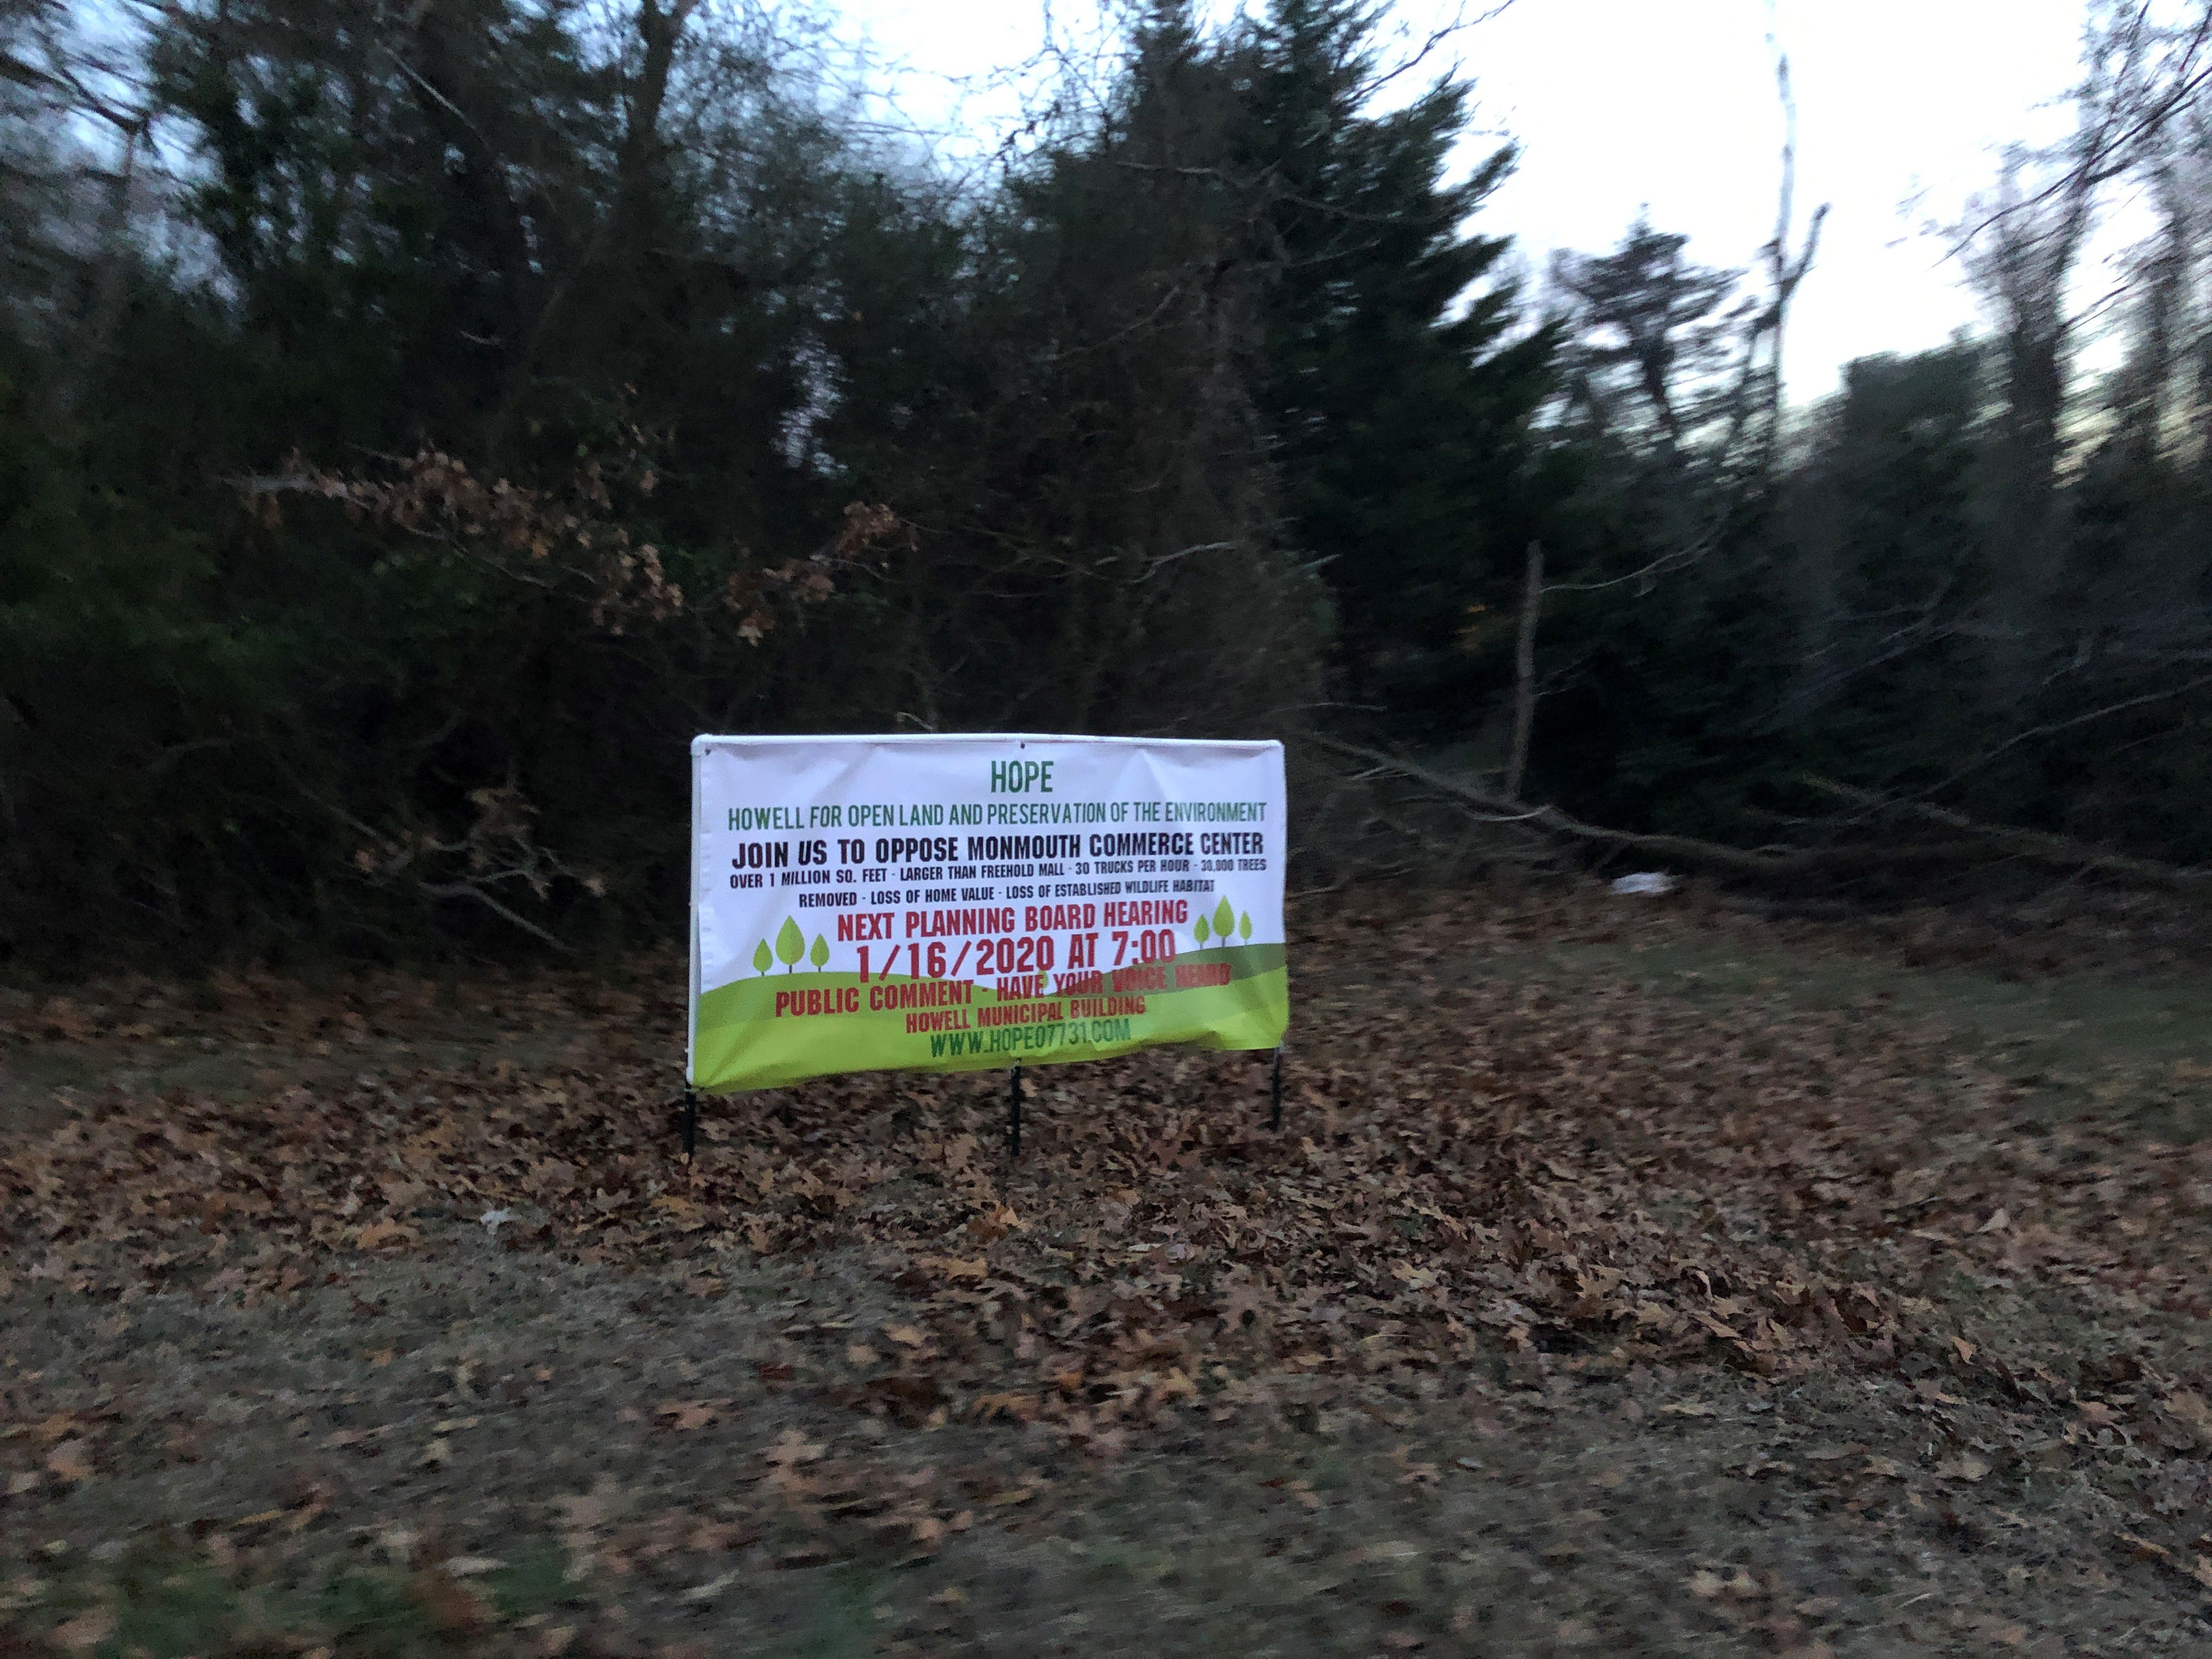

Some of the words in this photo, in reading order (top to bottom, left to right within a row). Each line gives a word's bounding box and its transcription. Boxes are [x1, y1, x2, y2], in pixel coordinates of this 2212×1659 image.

[991, 760, 1054, 793] HOPE
[729, 806, 804, 831] HOWELL
[810, 805, 842, 828] FOR
[848, 804, 894, 827] OPEN
[899, 804, 943, 826] LAND
[950, 804, 983, 825] AND
[987, 802, 1106, 825] PRESERVATION
[1110, 802, 1129, 822] OF
[1133, 802, 1160, 822] THE
[1165, 802, 1267, 822] ENVIRONMENT
[732, 841, 788, 870] JOIN
[798, 840, 827, 866] US
[837, 839, 865, 865] TO
[876, 837, 958, 862] OPPOSE
[968, 834, 1080, 861] MONMOUTH
[1090, 833, 1193, 857] COMMERCE
[1200, 832, 1263, 855] CENTER
[730, 873, 763, 889] OVER
[770, 873, 775, 887] 1
[781, 870, 830, 886] MILLION
[862, 868, 887, 882] FEET
[900, 866, 943, 881] LARGER
[948, 865, 976, 879] THAN
[981, 864, 1034, 878] FREEHOLD
[1039, 862, 1064, 877] MALL
[1075, 862, 1090, 874] 30
[1094, 861, 1133, 874] TRUCKS
[1138, 860, 1156, 872] PER
[1160, 859, 1189, 872] HOUR
[1238, 858, 1267, 871] TREES
[799, 892, 856, 908] REMOVED
[871, 890, 900, 905] LOSS
[906, 889, 920, 903] OF
[925, 888, 956, 903] HOME
[962, 887, 994, 901] VALUE
[1006, 885, 1034, 899] LOSS
[1039, 884, 1051, 898] OF
[1055, 881, 1121, 896] ESTABLISHED
[1125, 880, 1168, 893] WILDLIFE
[1173, 879, 1215, 892] HABITAT
[838, 912, 895, 941] NEXT
[906, 906, 1015, 938] PLANNING
[1025, 903, 1096, 932] BOARD
[1104, 899, 1187, 927] HEARING
[856, 935, 1054, 984] 1/16/2020
[1068, 932, 1098, 969] AT
[1112, 928, 1176, 966] 7:00
[775, 987, 859, 1017] PUBLIC
[870, 980, 973, 1011] COMMENT
[996, 974, 1045, 1002] HAVE
[1053, 970, 1103, 996] YOUR
[906, 1008, 970, 1034] HOWELL
[977, 1001, 1063, 1028] MUNICIPAL
[1070, 995, 1146, 1019] BUILDING
[930, 1018, 1130, 1058] WWW.HOPE07731.COM
